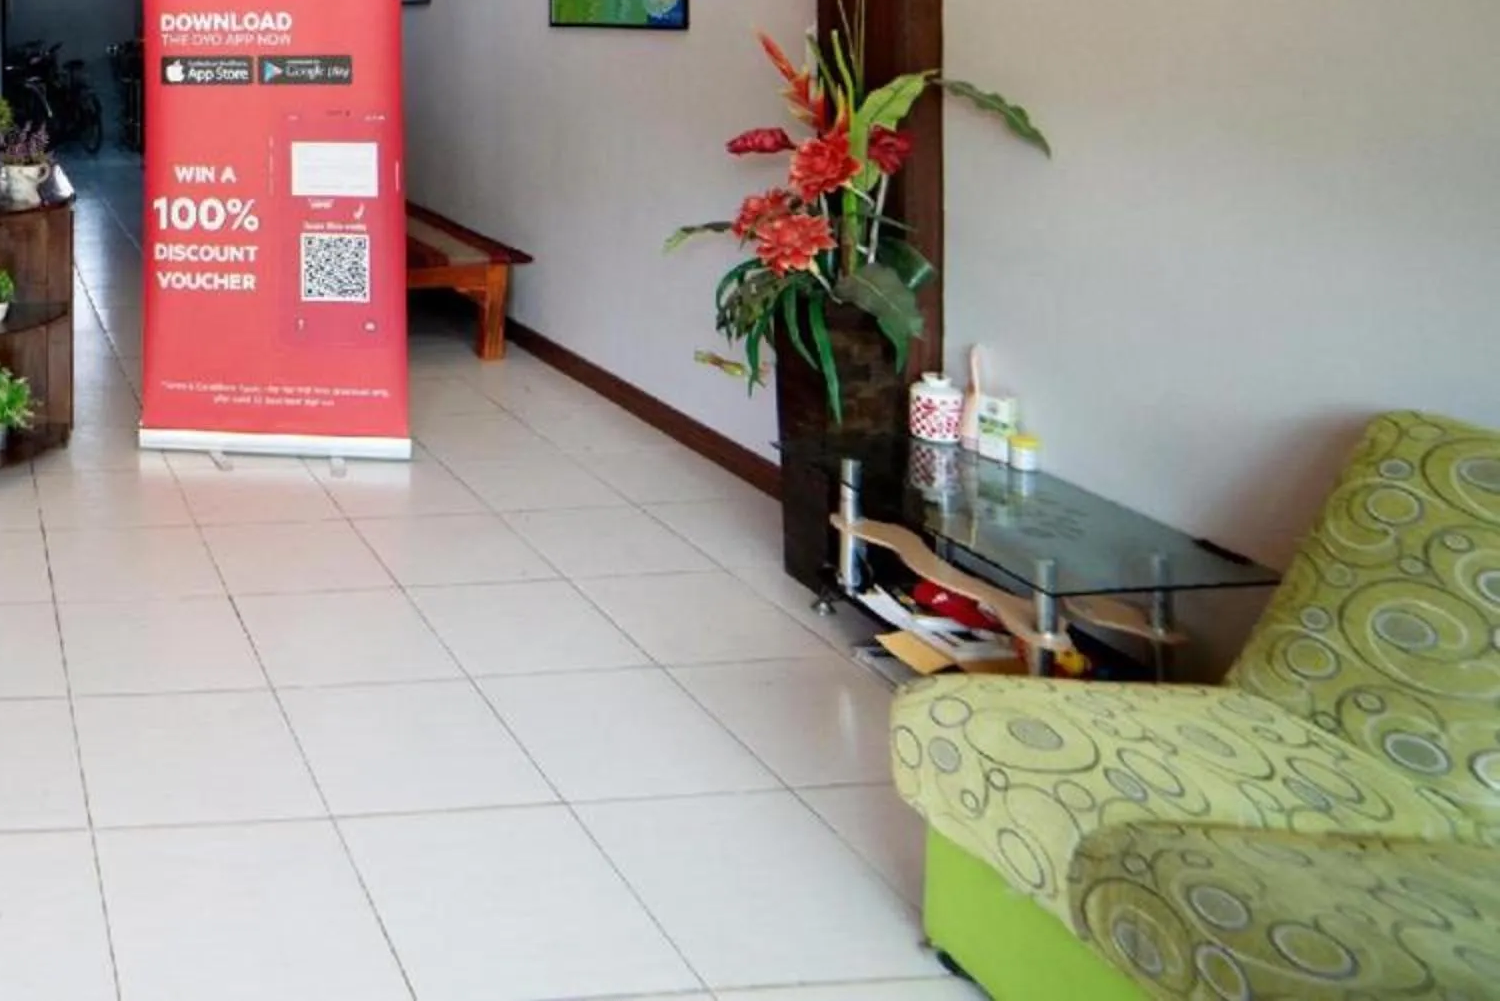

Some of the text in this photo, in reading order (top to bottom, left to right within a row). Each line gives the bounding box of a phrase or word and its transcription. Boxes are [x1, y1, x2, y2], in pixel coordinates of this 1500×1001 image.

[160, 11, 292, 31] DOWNLOAD
[161, 33, 188, 46] THE
[226, 32, 254, 45] APP
[187, 65, 249, 82] App Store
[174, 165, 236, 183] WIN A
[153, 197, 259, 231] 100%
[154, 245, 258, 262] DISCOUNT
[157, 271, 256, 290] VOUCHER
